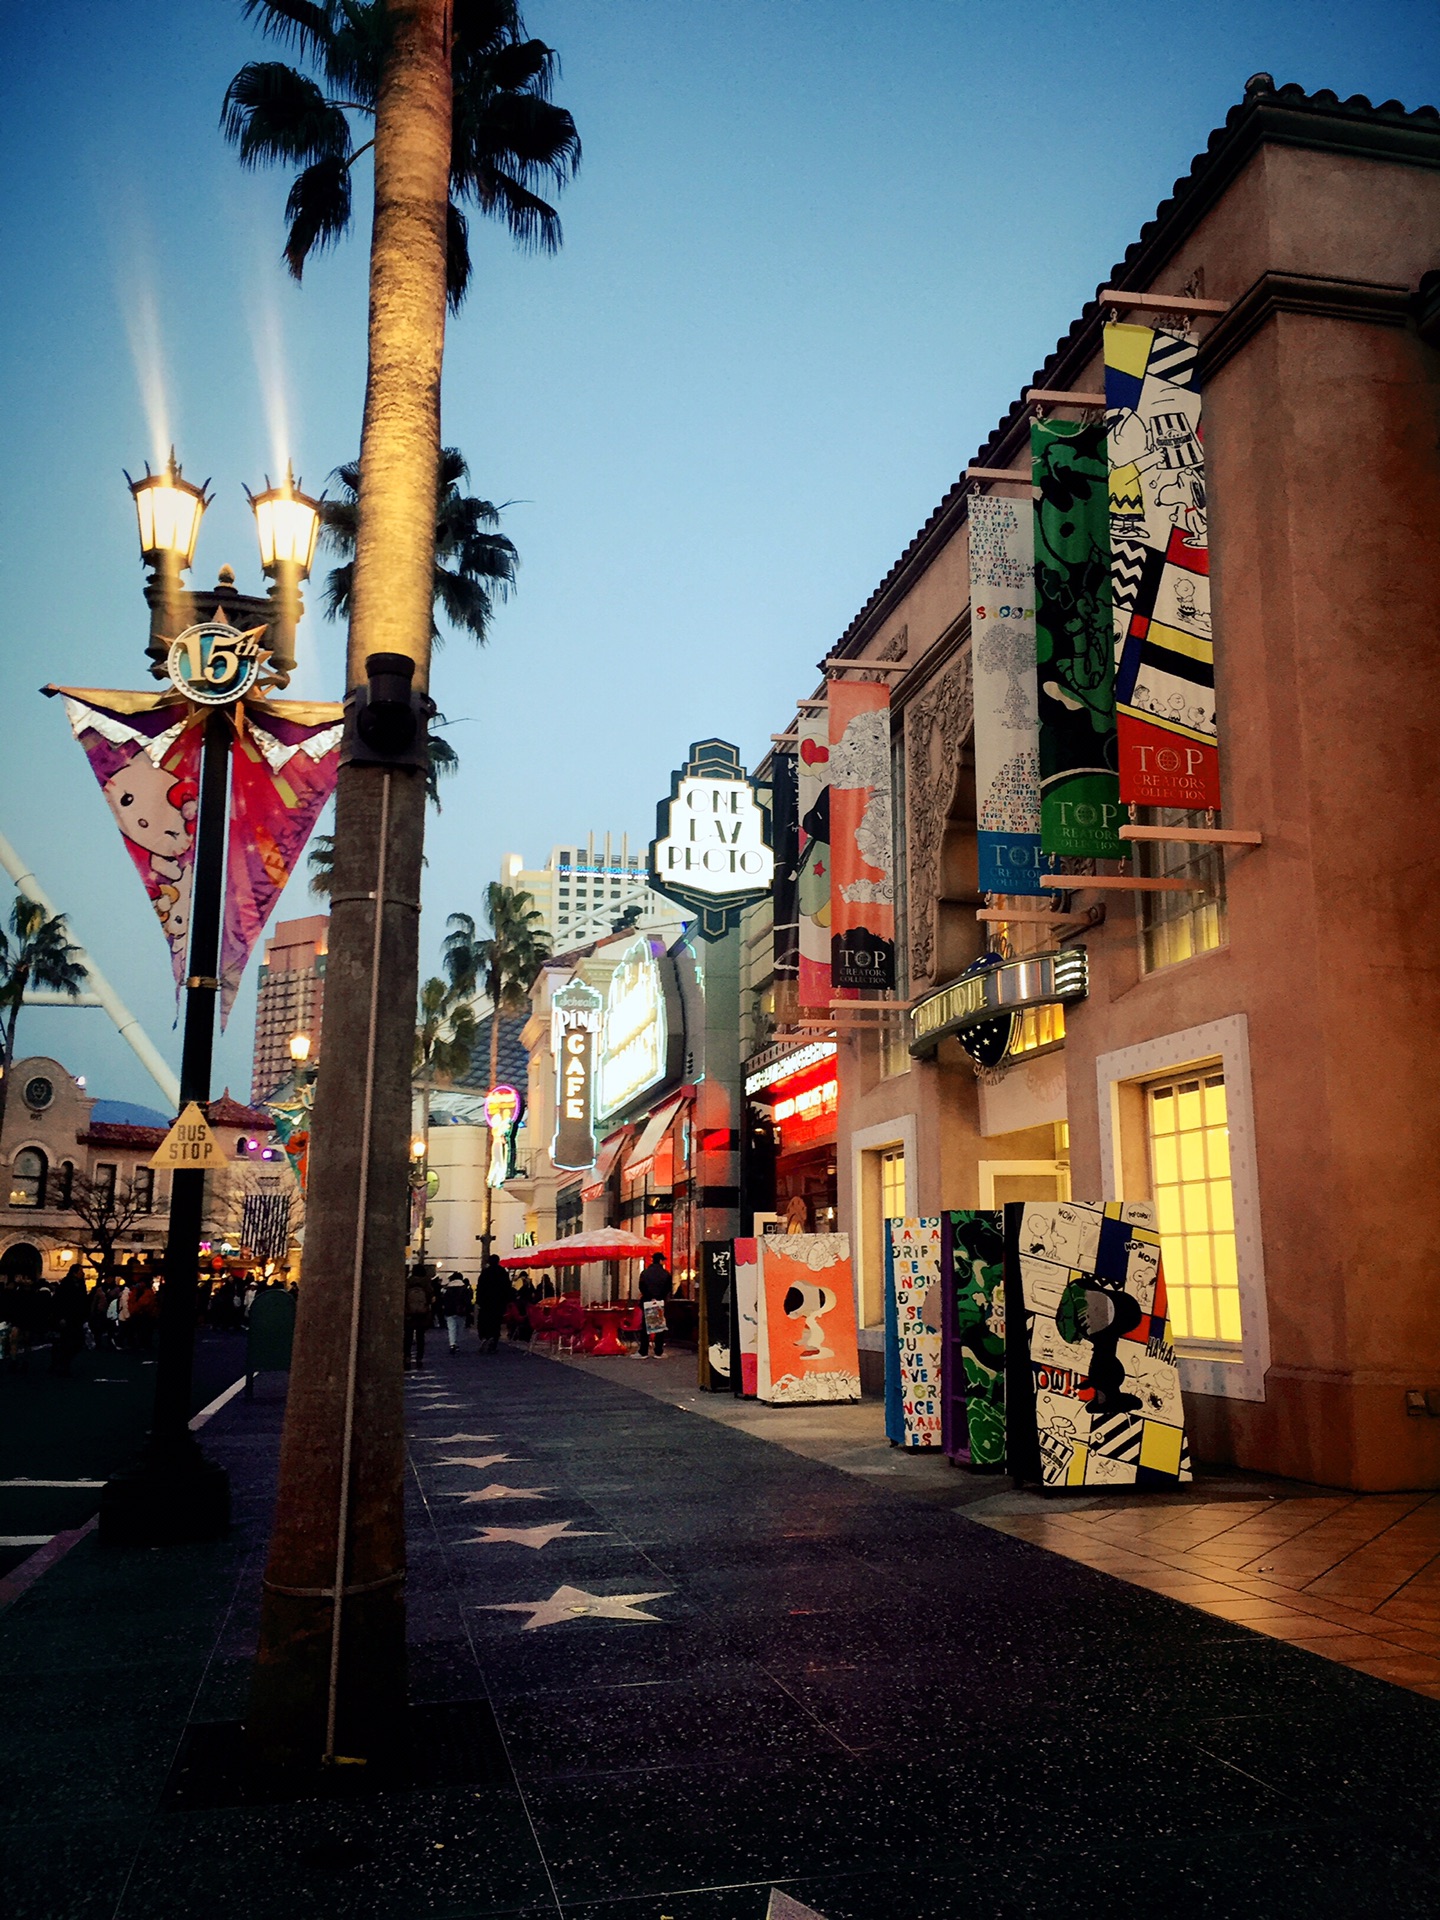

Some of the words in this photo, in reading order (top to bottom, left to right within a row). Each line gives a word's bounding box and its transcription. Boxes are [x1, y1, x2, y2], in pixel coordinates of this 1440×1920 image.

[176, 633, 260, 684] 15th
[1132, 745, 1204, 776] TOP
[1133, 774, 1206, 789] CREATORS
[686, 788, 745, 815] ONE
[1133, 786, 1206, 800] COLLECTION
[1053, 801, 1118, 829] TOP
[668, 846, 764, 875] PHOTO
[989, 844, 1048, 869] TOP
[575, 865, 600, 873] PARK
[840, 949, 886, 969] TOP
[840, 967, 886, 977] CREATORS
[566, 1033, 586, 1120] CAFE
[177, 1125, 206, 1141] BUS
[169, 1142, 213, 1160] STOP
[1057, 1207, 1077, 1223] WOW!
[1032, 1366, 1082, 1398] OW!!
